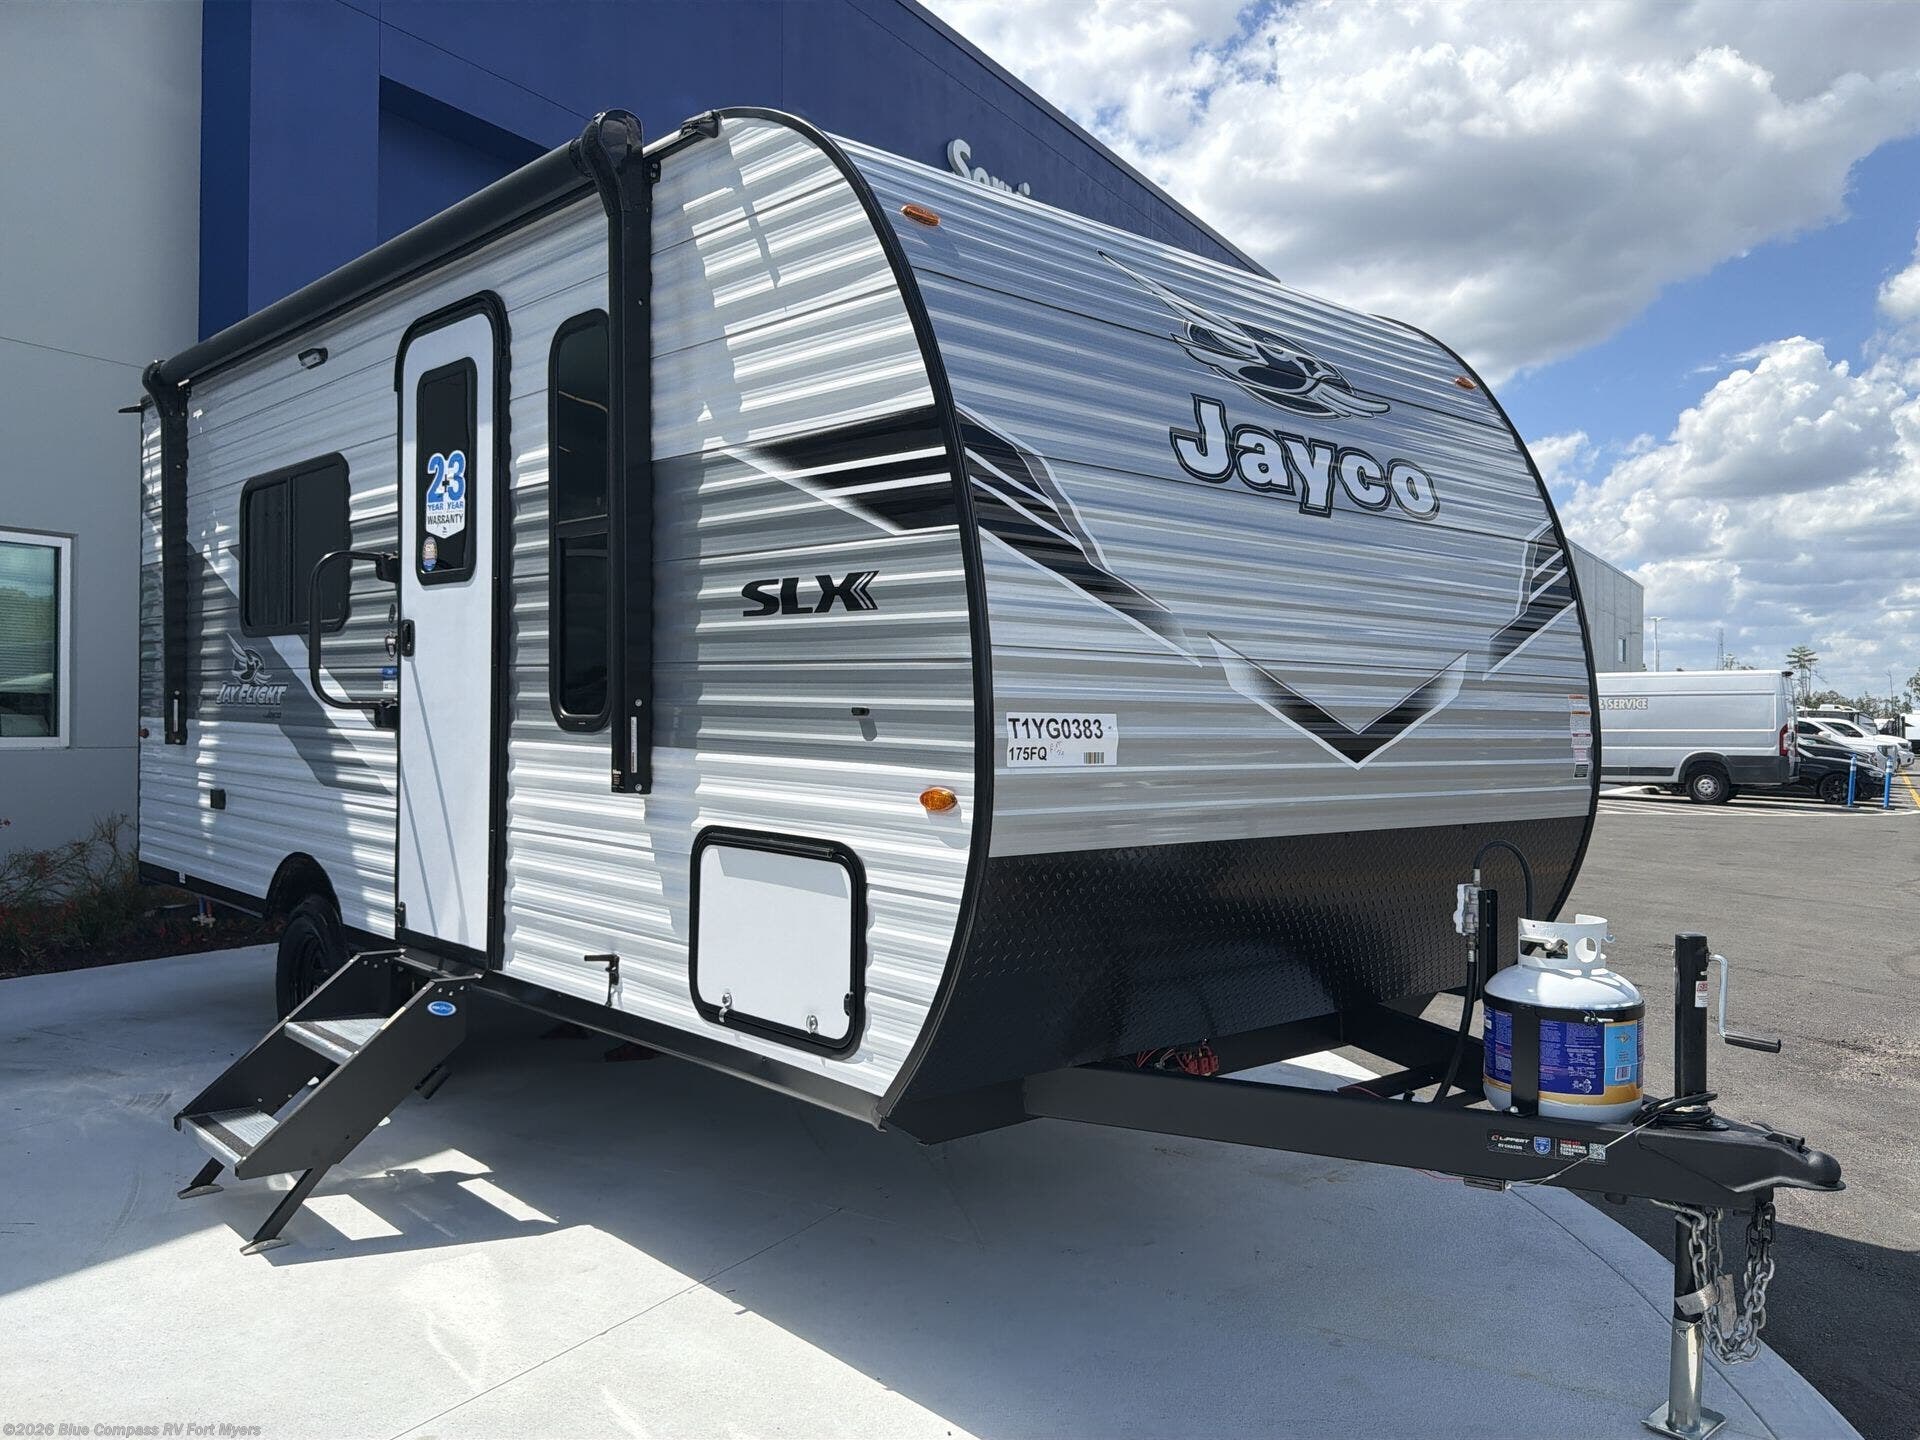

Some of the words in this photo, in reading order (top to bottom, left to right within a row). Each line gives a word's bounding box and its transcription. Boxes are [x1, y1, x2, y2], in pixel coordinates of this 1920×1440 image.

[1169, 393, 1440, 520] Jayco
[427, 503, 444, 511] YEAR
[447, 501, 464, 510] YEAR
[427, 513, 464, 525] WARRANTY
[741, 570, 880, 617] SLX
[216, 683, 240, 705] JAY
[239, 683, 288, 705] FLIGHT
[1607, 698, 1648, 710] SERVICE
[1008, 718, 1104, 739] T1YG0383
[1009, 746, 1047, 761] 175FQ
